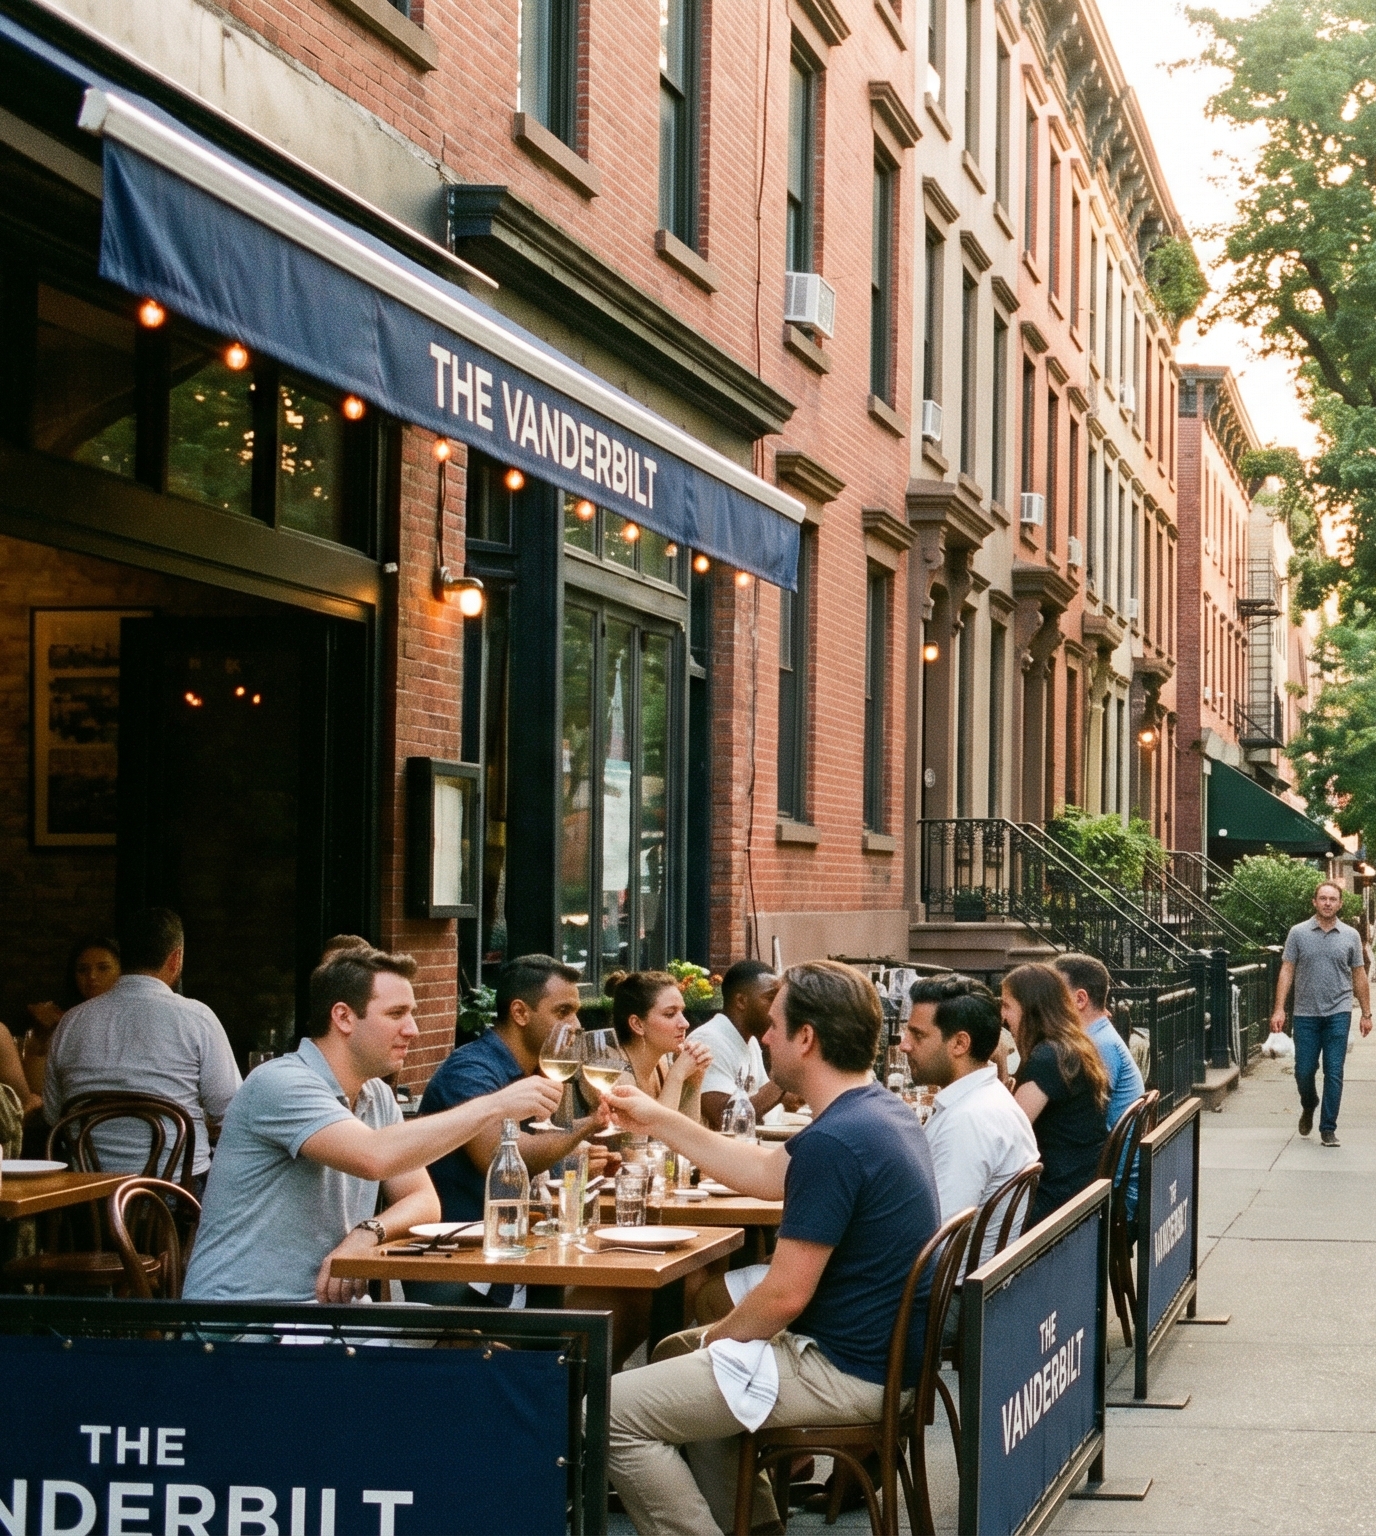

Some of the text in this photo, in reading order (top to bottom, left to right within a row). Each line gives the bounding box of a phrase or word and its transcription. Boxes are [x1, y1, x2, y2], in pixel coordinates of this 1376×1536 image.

[429, 341, 658, 509] THE VANDERBILT
[1039, 1310, 1057, 1354] THE
[1001, 1327, 1084, 1456] VANDERBILT
[80, 1424, 186, 1466] THE
